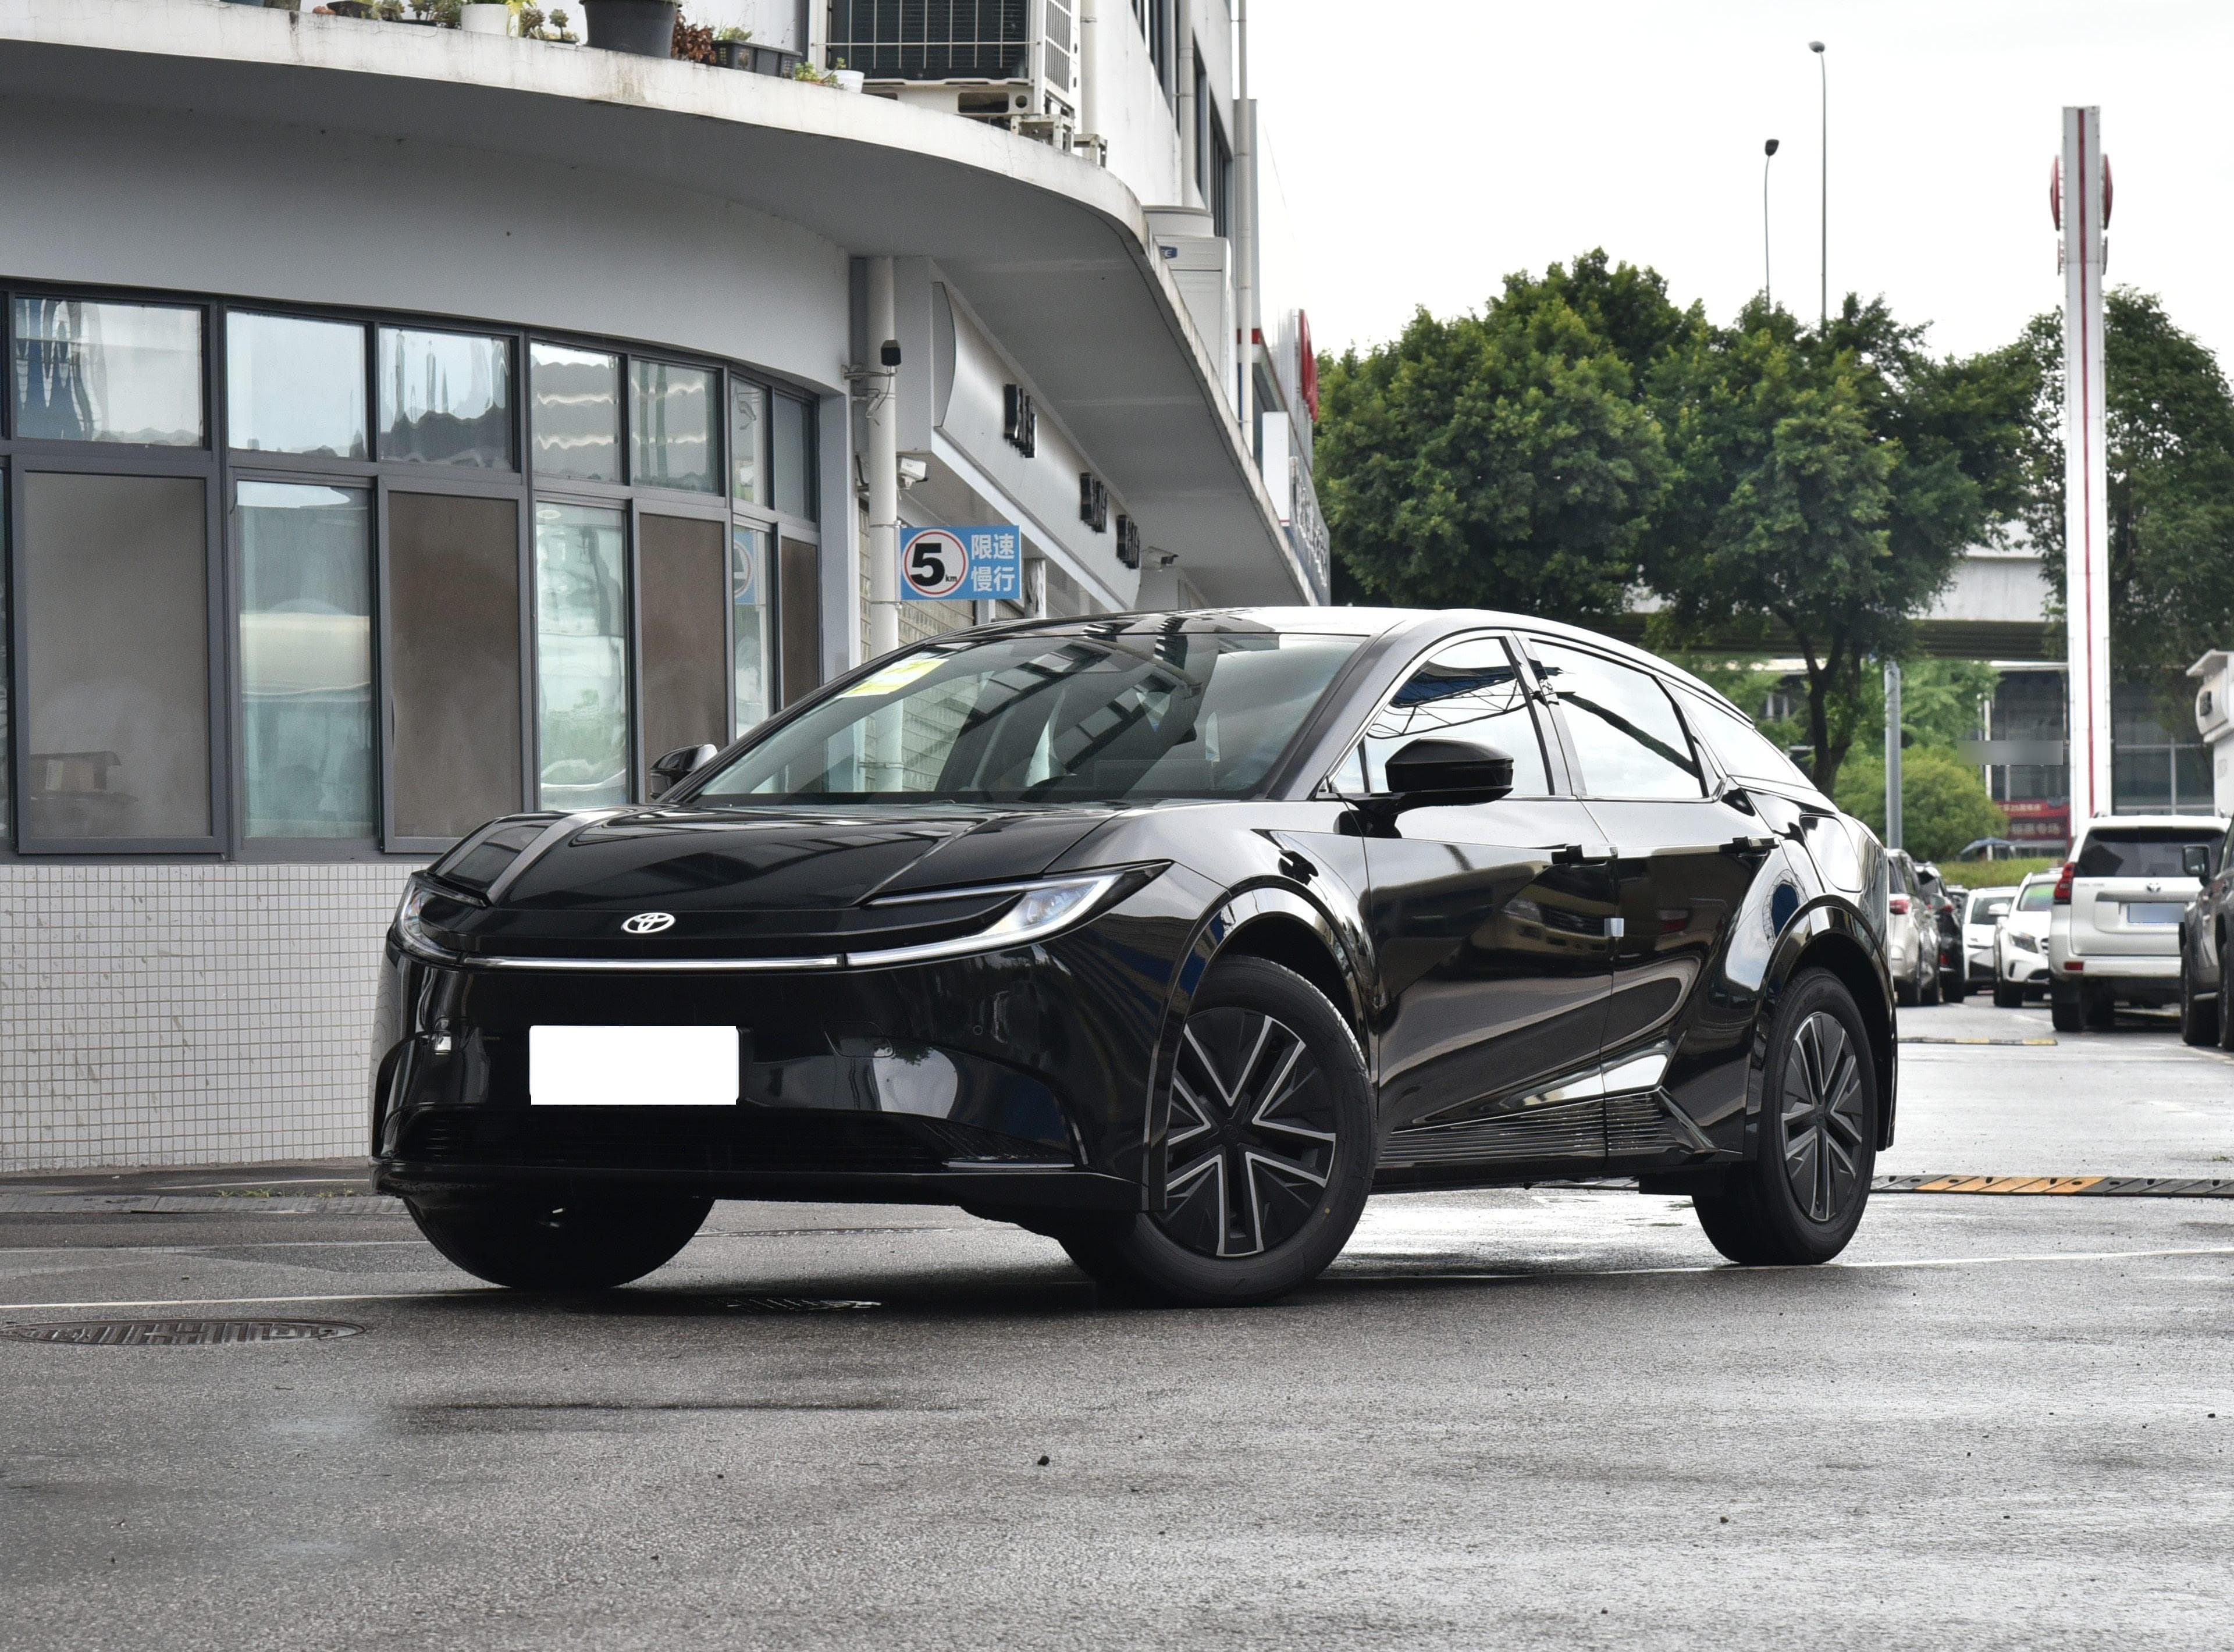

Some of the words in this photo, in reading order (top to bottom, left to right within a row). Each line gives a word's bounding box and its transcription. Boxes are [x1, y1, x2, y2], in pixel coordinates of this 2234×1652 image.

[971, 534, 1014, 559] 限速
[911, 543, 944, 586] 5
[972, 567, 1015, 591] 慢行
